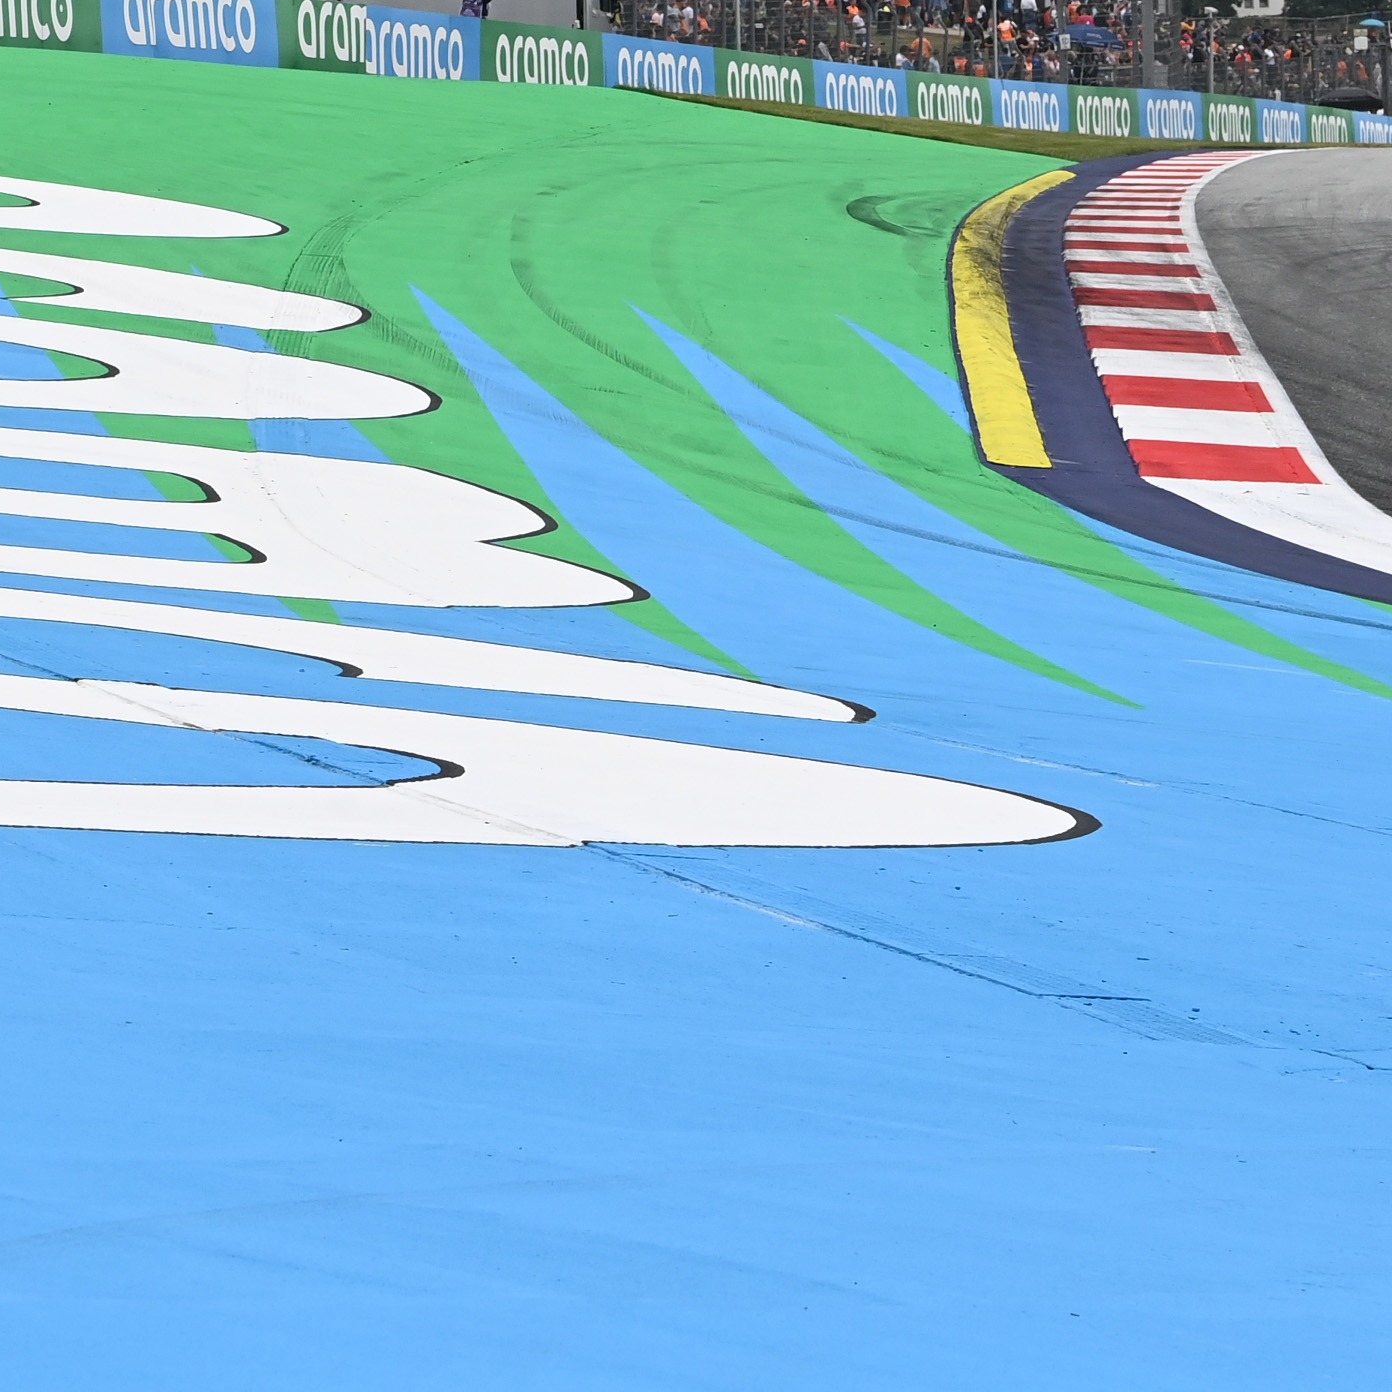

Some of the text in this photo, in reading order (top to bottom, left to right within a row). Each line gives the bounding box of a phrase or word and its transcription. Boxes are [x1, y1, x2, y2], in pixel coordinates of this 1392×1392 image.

[495, 33, 590, 86] aramco
[617, 47, 703, 95] aramco
[727, 61, 804, 105] aramco
[825, 72, 897, 117] aramco
[917, 81, 983, 126] aramco
[1001, 89, 1060, 132] aramco
[1076, 95, 1131, 138] aramco
[1146, 99, 1196, 140] aramco
[1208, 102, 1252, 143] aramco
[1262, 108, 1302, 144] aramco
[1311, 114, 1348, 143] aramco
